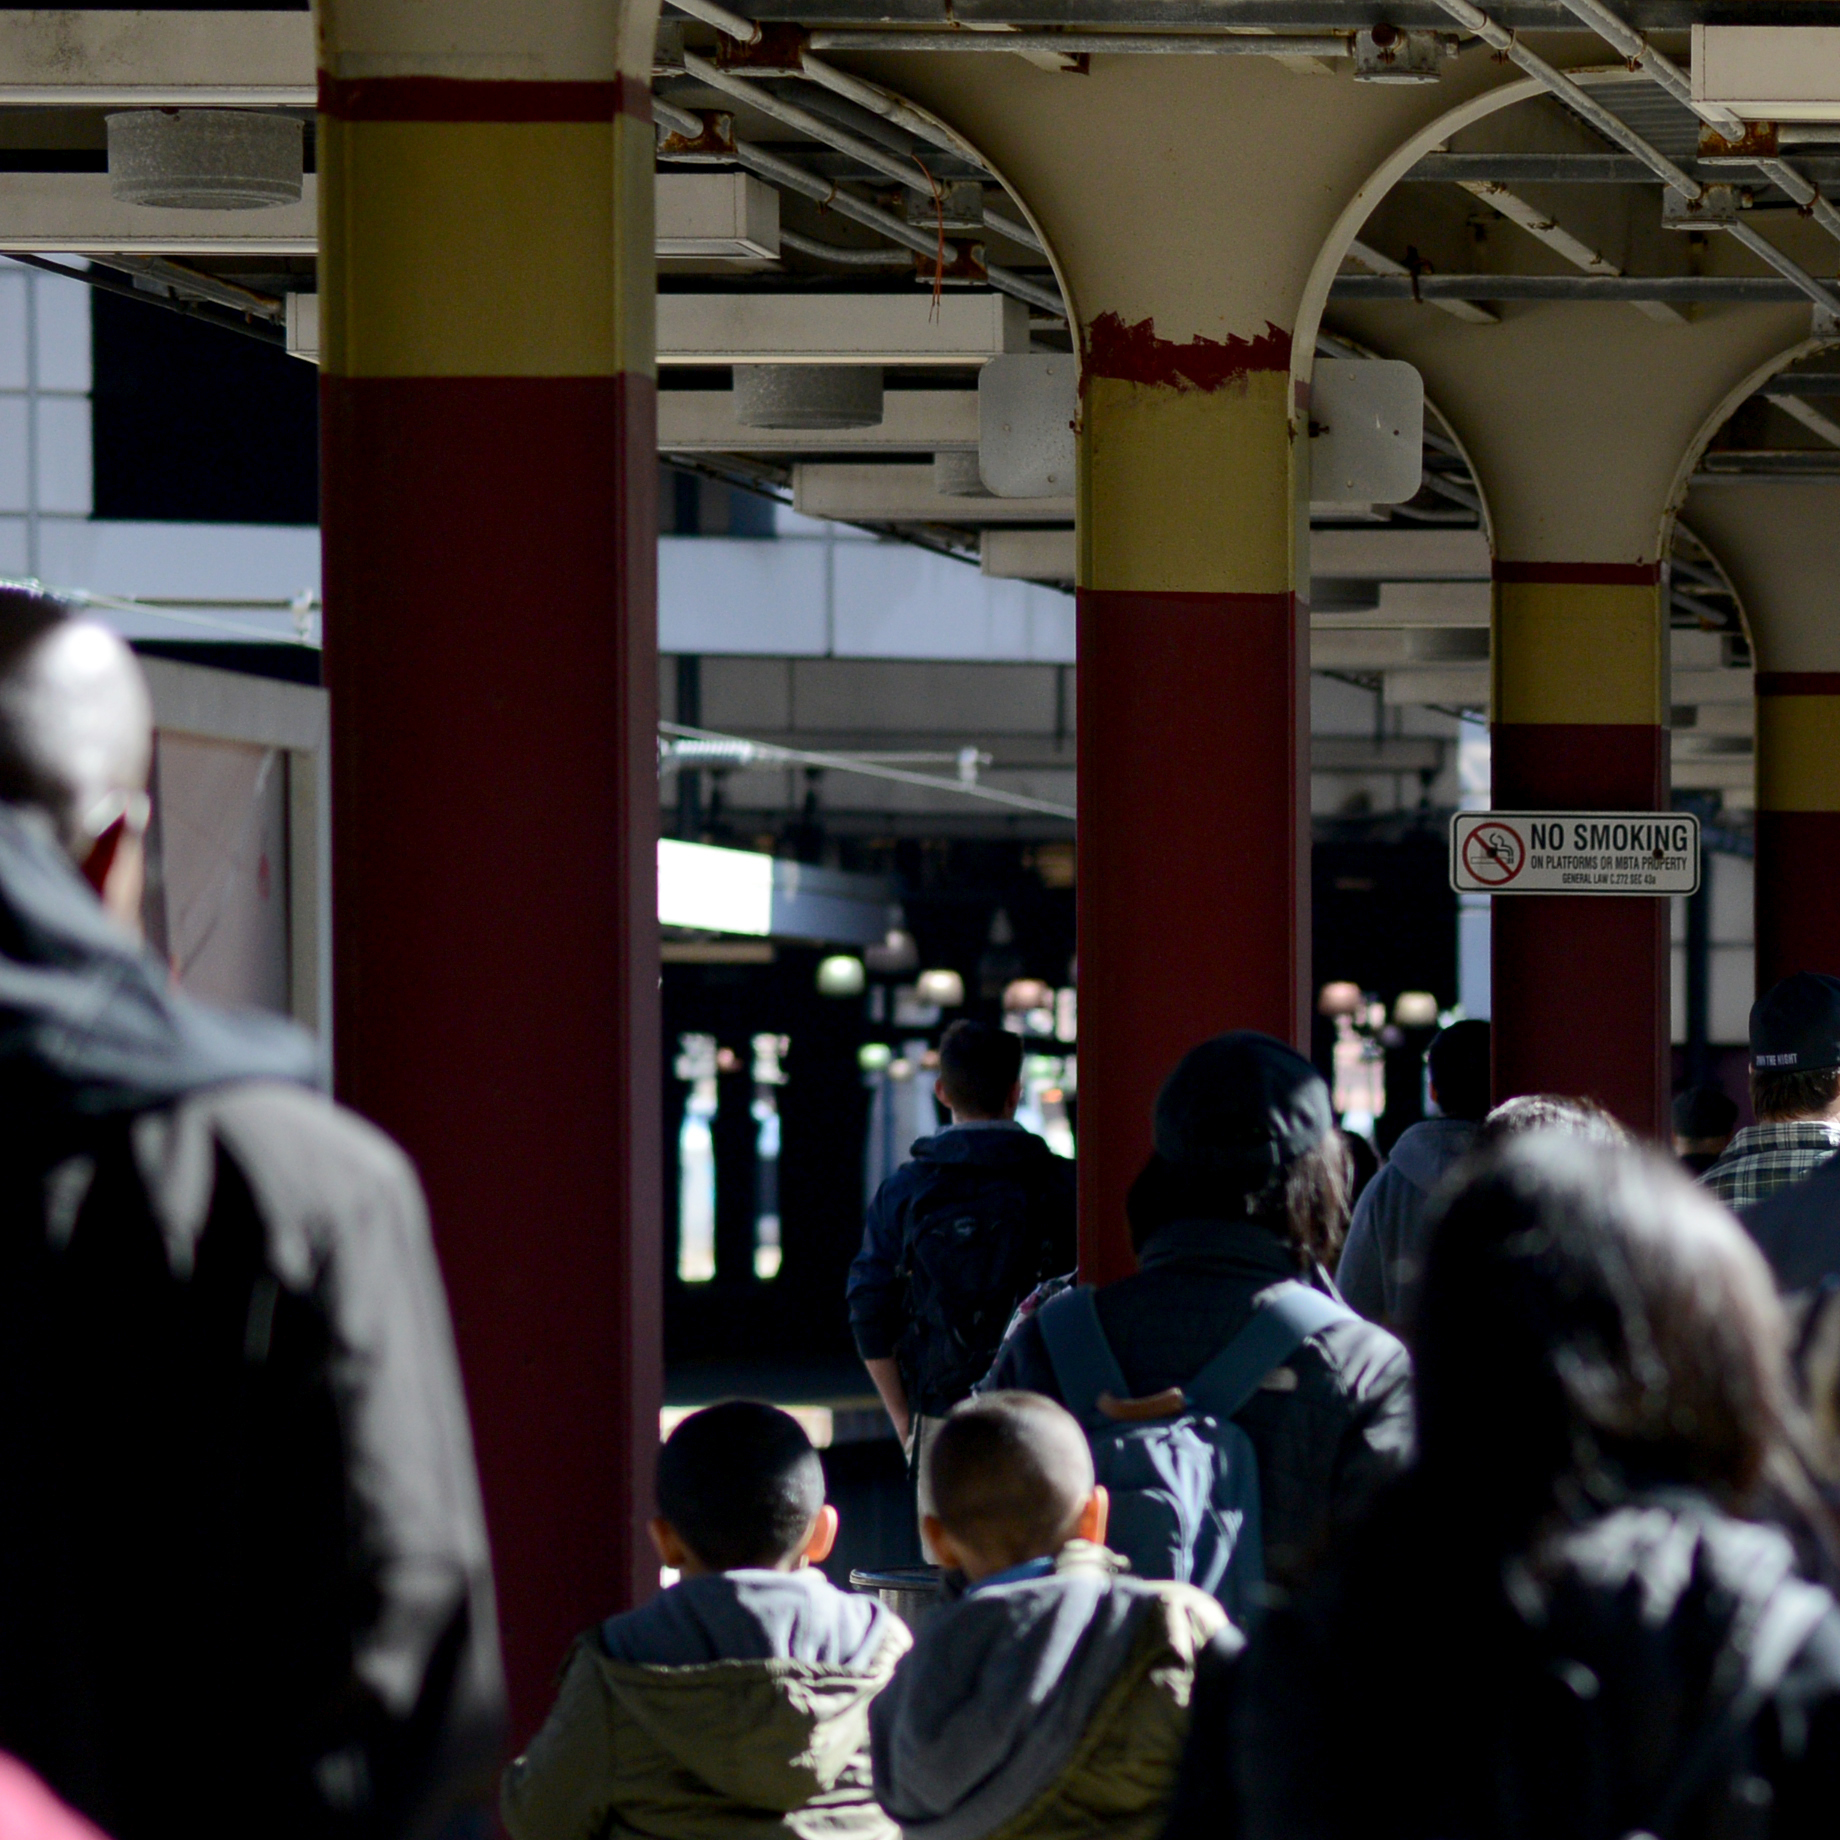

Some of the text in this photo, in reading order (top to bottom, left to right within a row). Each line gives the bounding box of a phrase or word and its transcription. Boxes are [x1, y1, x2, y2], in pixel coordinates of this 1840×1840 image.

[1531, 823, 1688, 851] NO SMOKING
[1531, 855, 1688, 871] ON PLATFORMS OR MBTA PROPERTY
[1562, 873, 1592, 884] GENERAL
[1593, 873, 1608, 884] LAW
[1630, 874, 1643, 885] SEC
